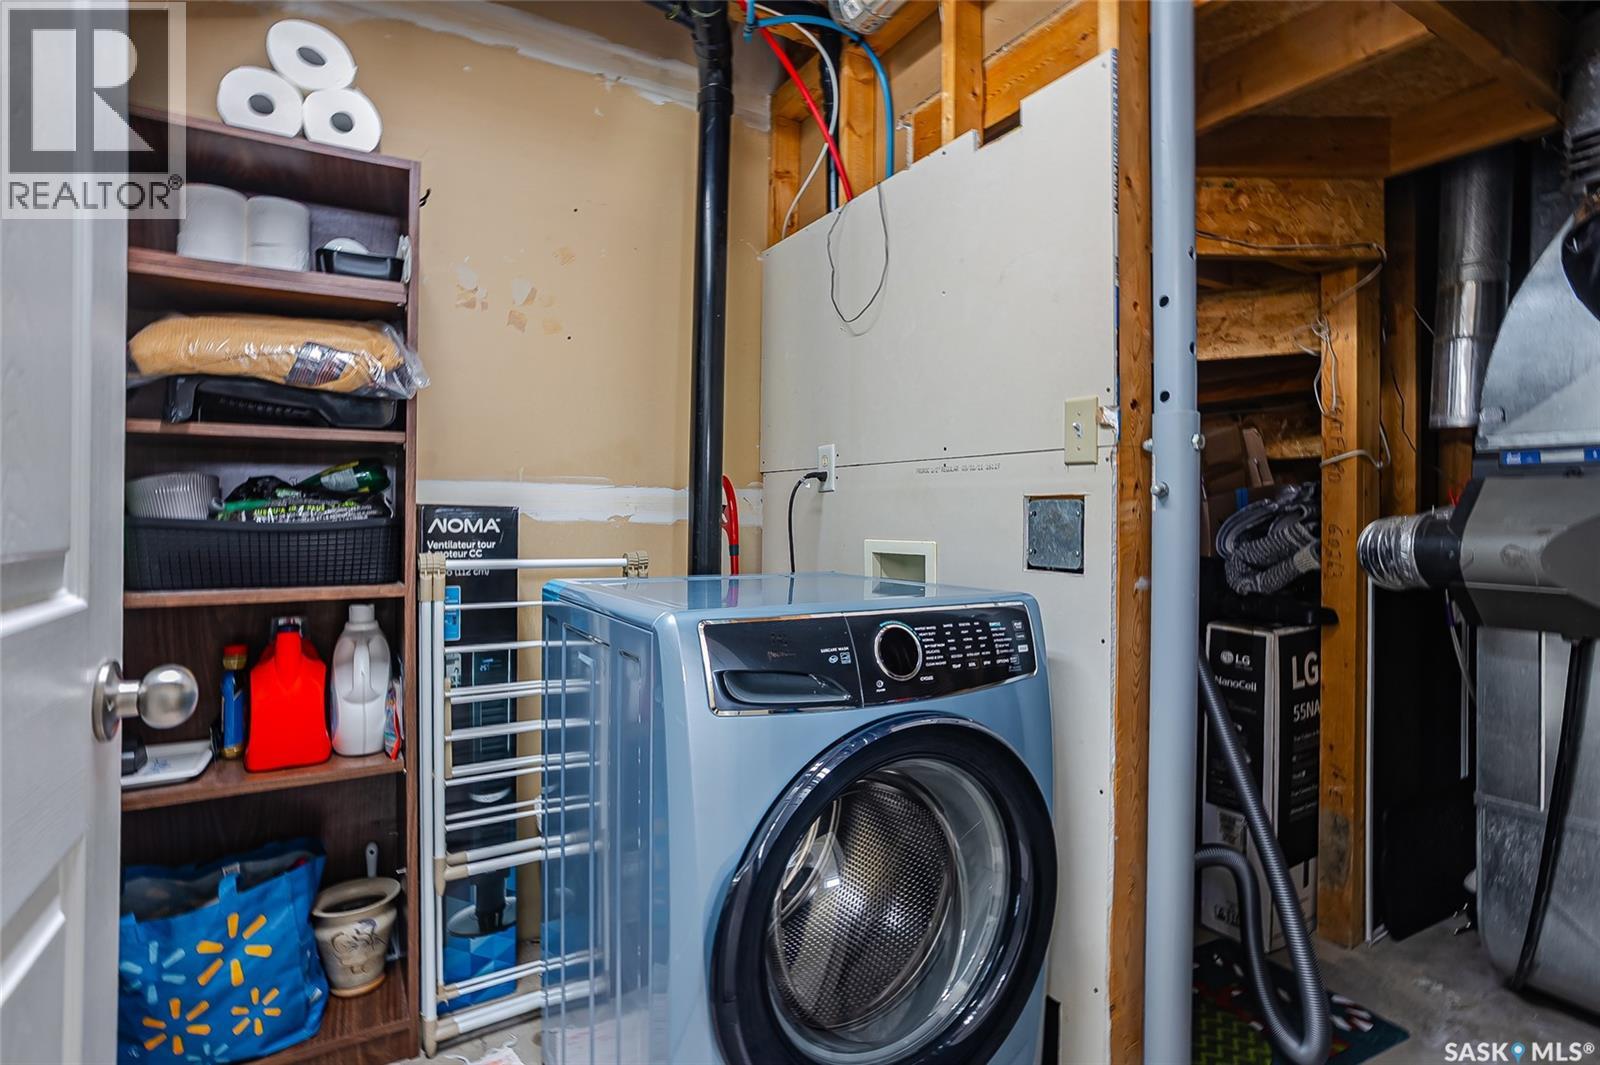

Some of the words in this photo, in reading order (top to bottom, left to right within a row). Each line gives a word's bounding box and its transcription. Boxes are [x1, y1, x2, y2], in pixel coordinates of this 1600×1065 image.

[428, 518, 500, 533] NOMA
[427, 540, 476, 549] Ventilateur
[477, 540, 496, 549] tour
[469, 549, 482, 558] CC
[1235, 653, 1250, 666] LG
[1292, 651, 1319, 690] LG
[1293, 699, 1321, 723] 55NA
